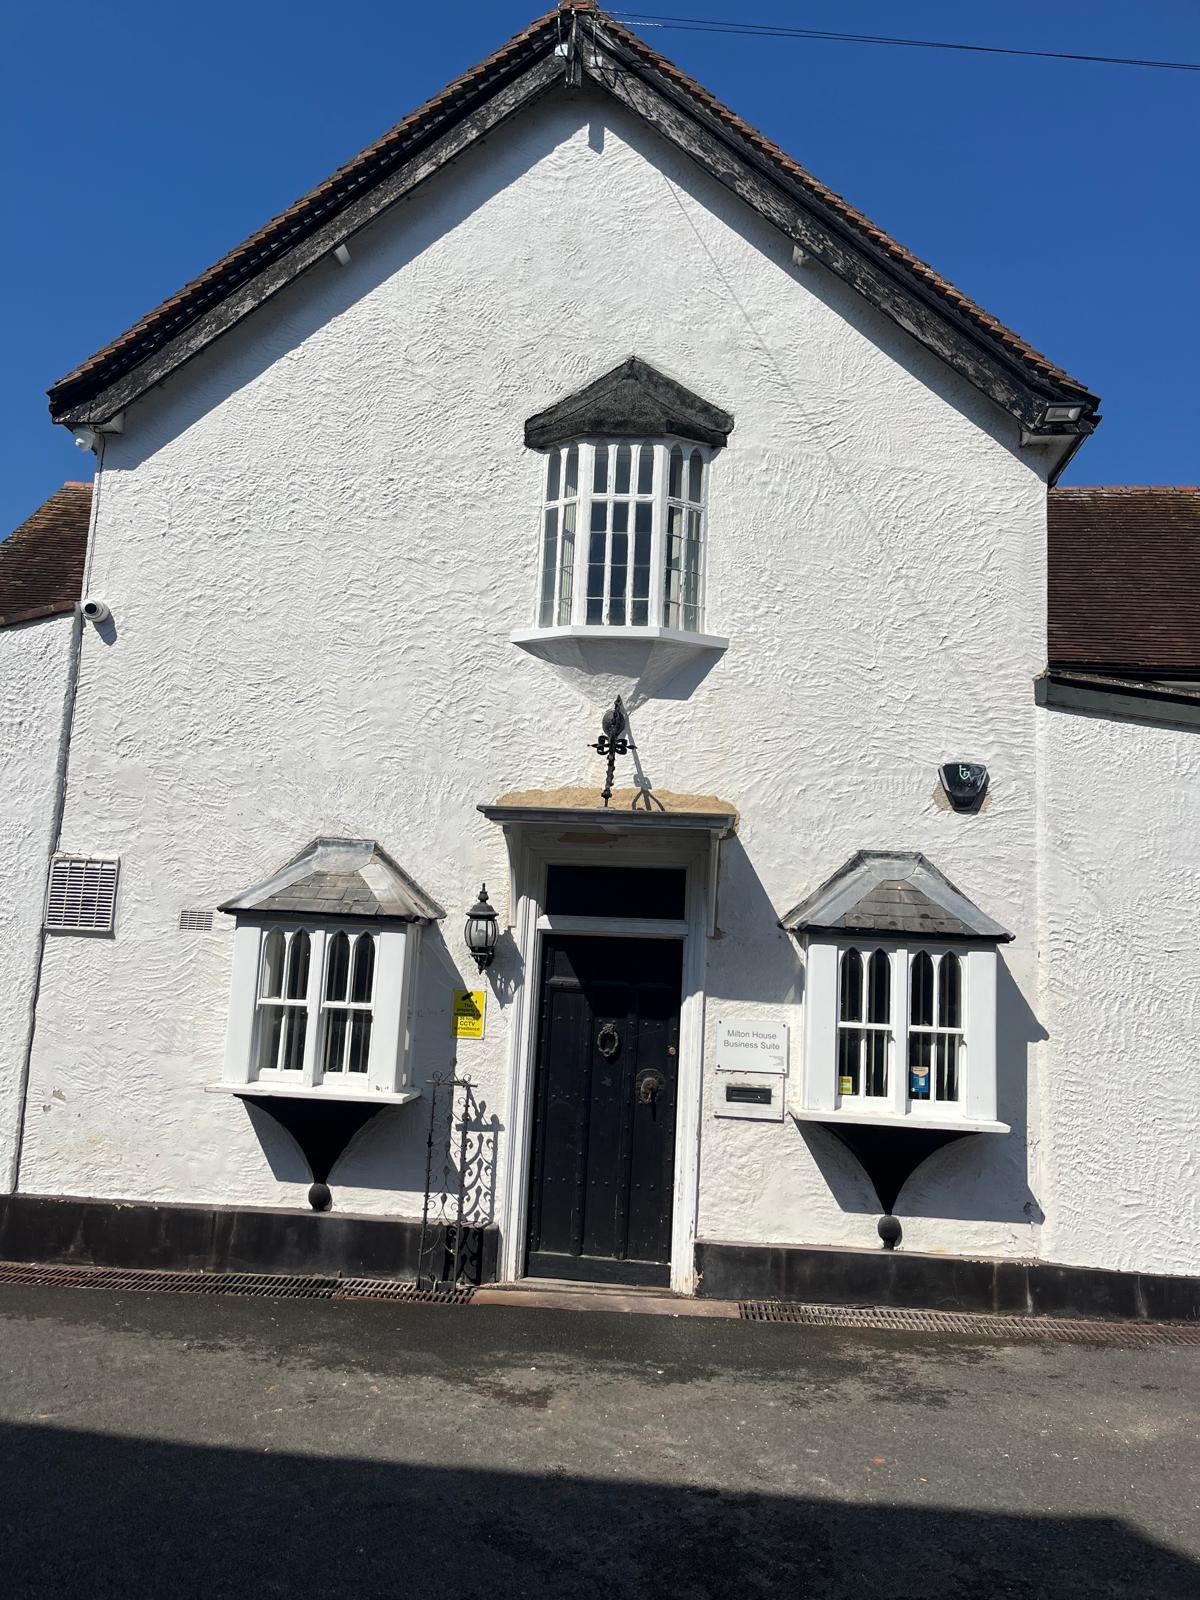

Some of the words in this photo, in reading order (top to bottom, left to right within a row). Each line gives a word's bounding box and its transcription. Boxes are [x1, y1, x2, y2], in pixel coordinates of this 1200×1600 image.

[727, 1029, 750, 1038] Milton
[752, 1031, 777, 1040] House
[723, 1039, 759, 1049] Business
[760, 1041, 780, 1050] Suite
